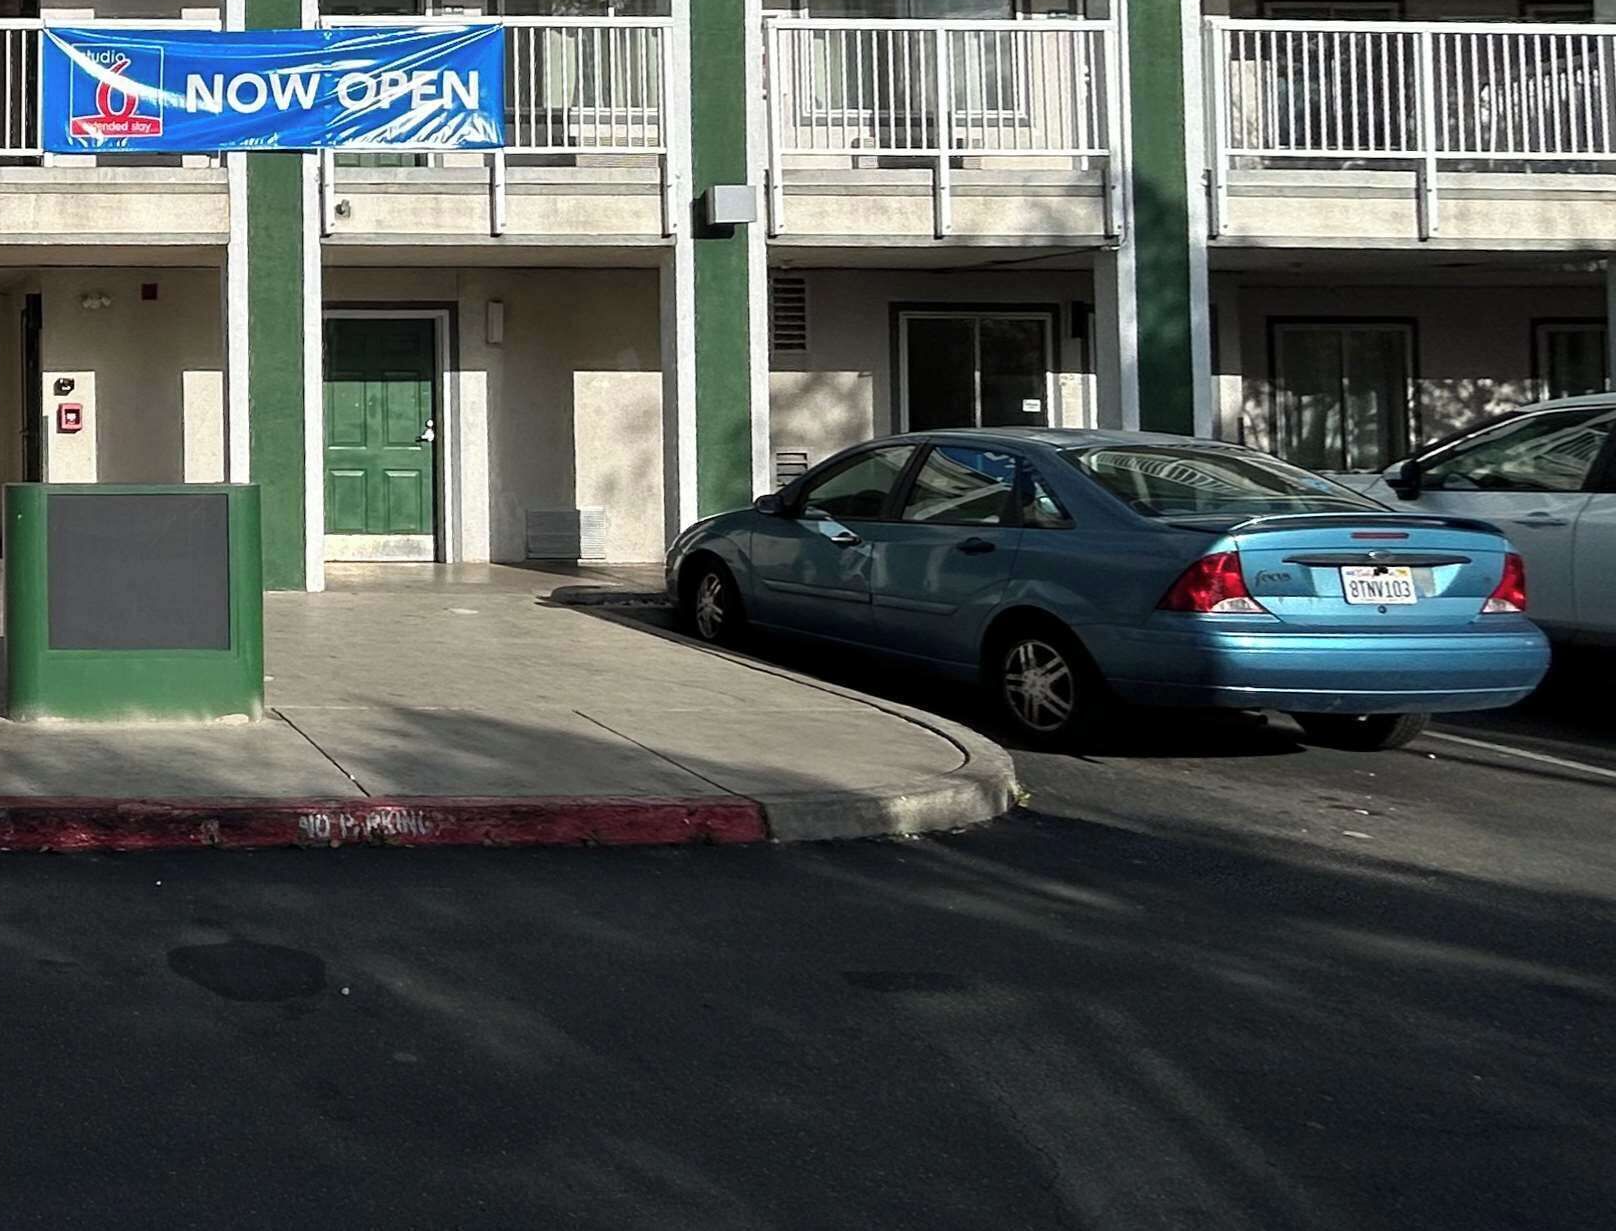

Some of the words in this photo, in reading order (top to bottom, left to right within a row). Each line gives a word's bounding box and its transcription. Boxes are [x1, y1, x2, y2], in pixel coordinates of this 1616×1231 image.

[81, 49, 126, 65] tudio
[185, 71, 321, 114] NOW
[336, 69, 481, 111] OPEN
[1349, 579, 1413, 599] 8TNV103
